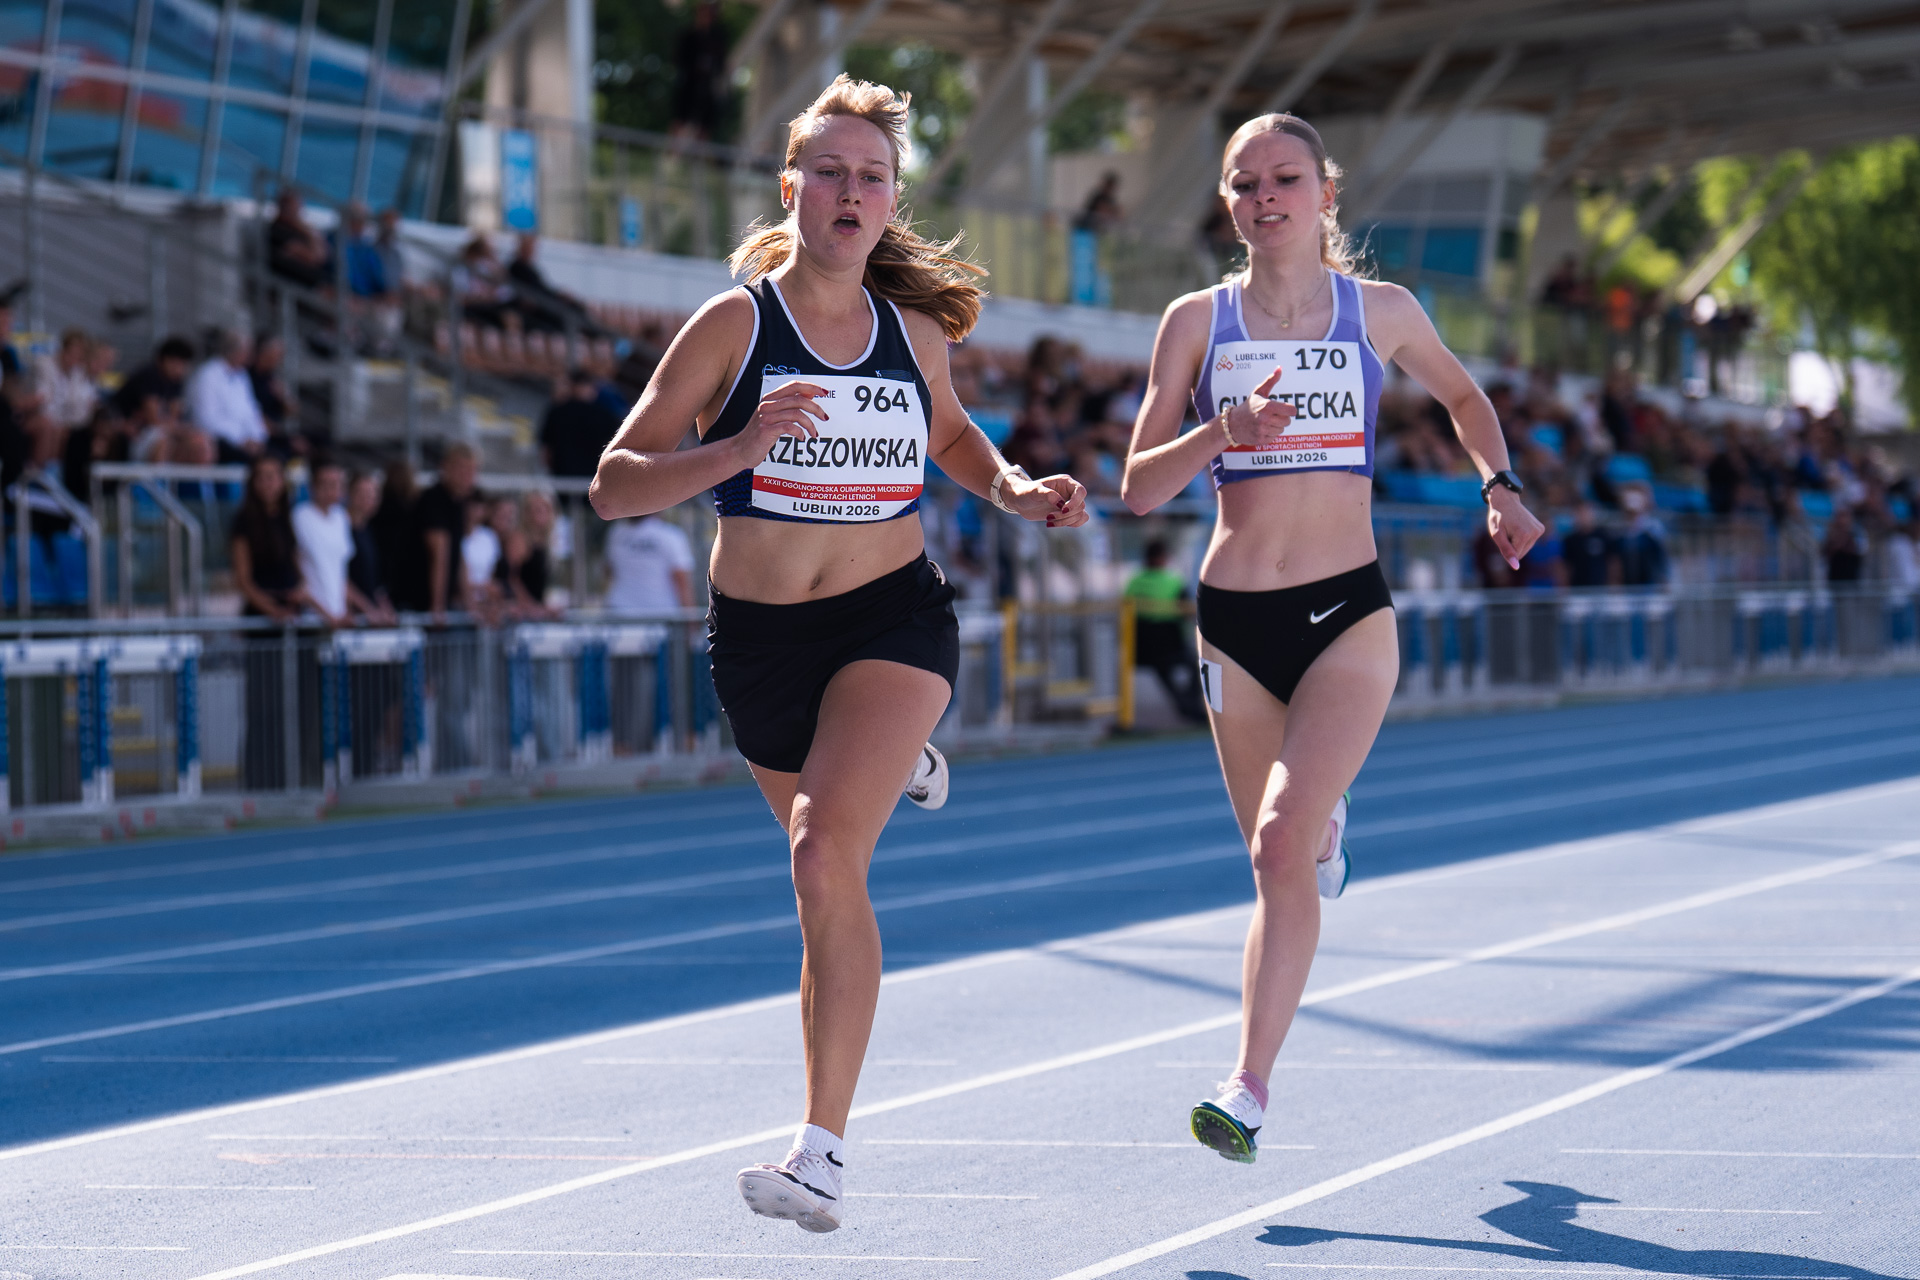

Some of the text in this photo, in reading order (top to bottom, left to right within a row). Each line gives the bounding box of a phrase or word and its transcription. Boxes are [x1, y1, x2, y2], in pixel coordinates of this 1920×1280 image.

[1235, 353, 1276, 361] LUBELSKIE
[1295, 348, 1347, 370] 170
[854, 385, 909, 413] 964
[1288, 435, 1321, 443] OLIMPIADA
[1262, 443, 1296, 451] SPORTACH
[1251, 452, 1328, 465] LUBLIN 2026
[763, 478, 781, 486] XXXII
[782, 481, 838, 492] OGÓLNOPOLSKA
[877, 485, 914, 493] MŁODZIEŻY
[809, 492, 847, 500] SPORTACH
[793, 501, 880, 516] LUBLIN 2026
